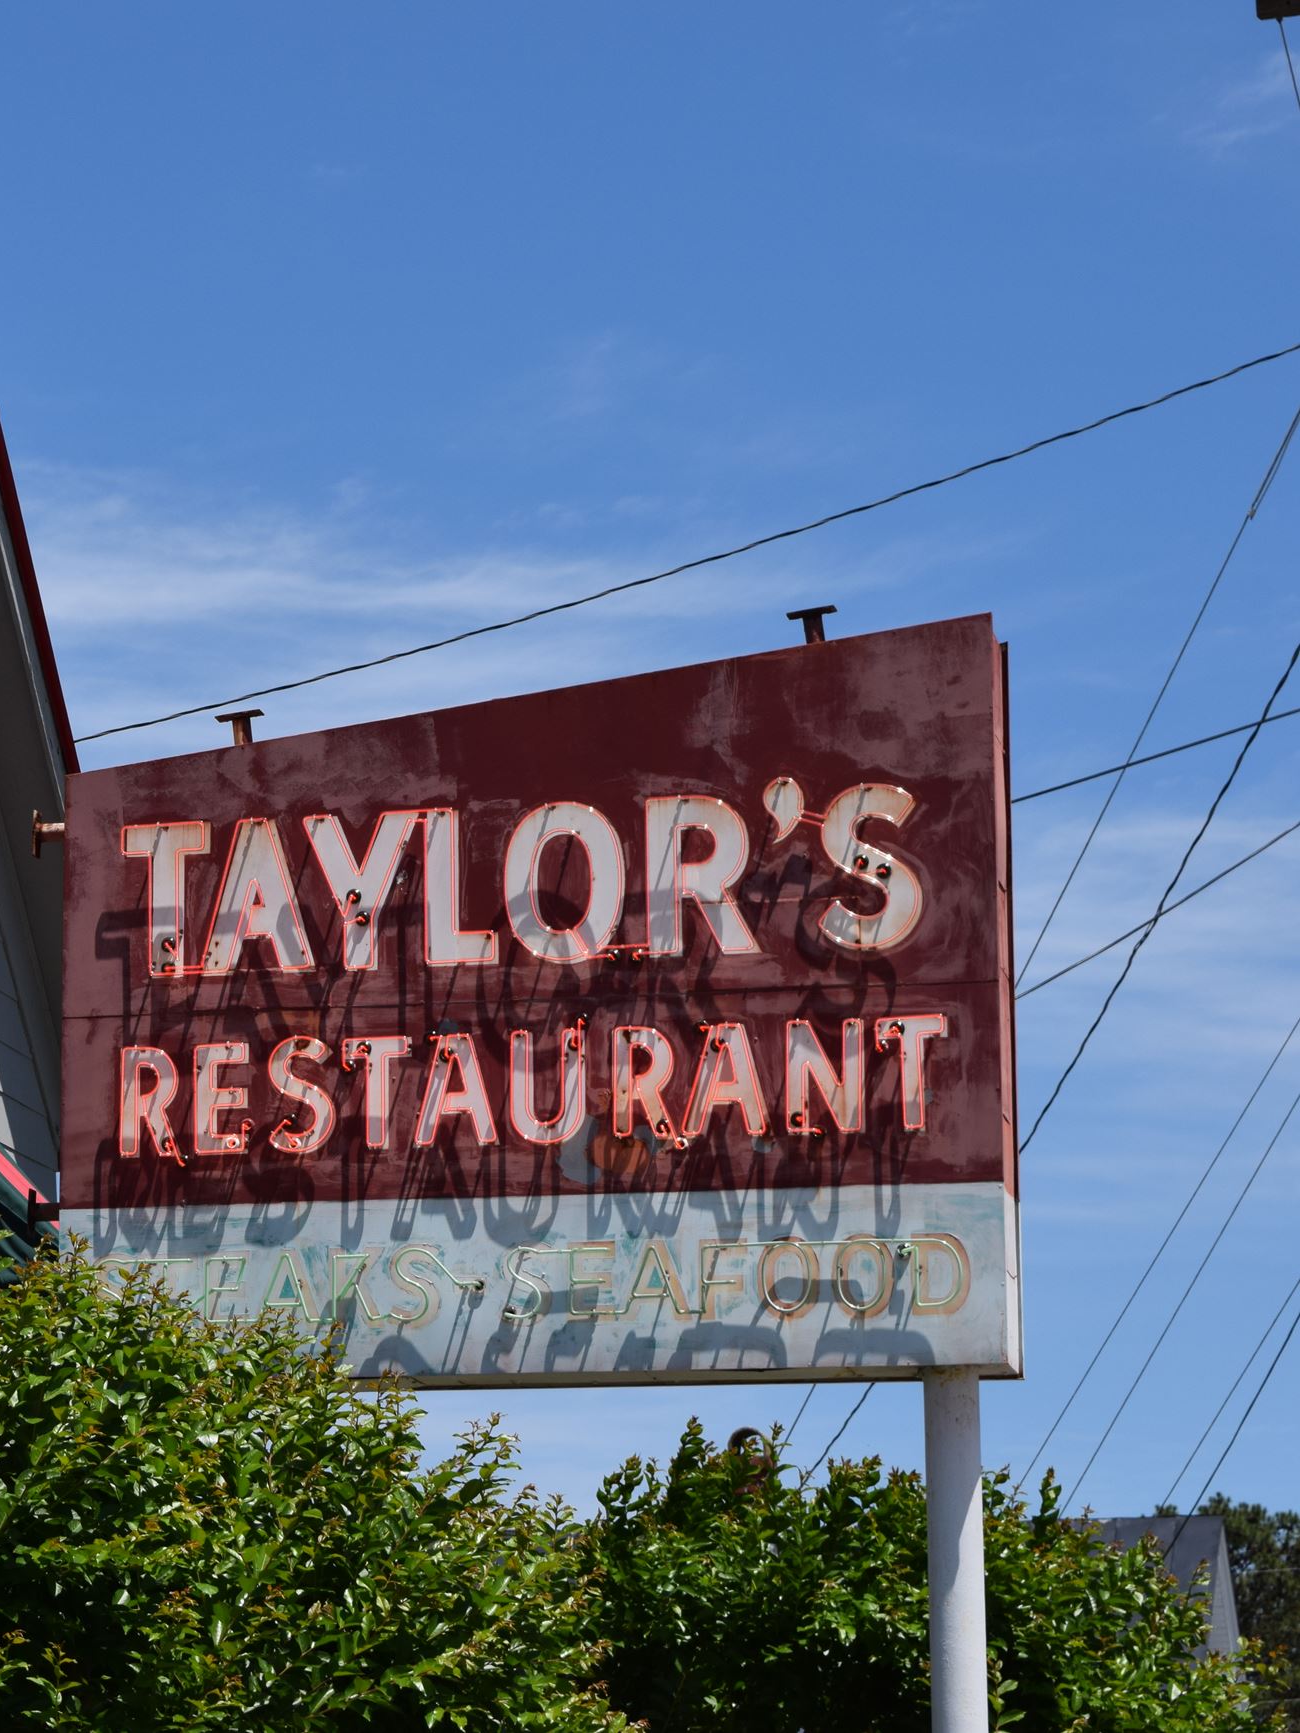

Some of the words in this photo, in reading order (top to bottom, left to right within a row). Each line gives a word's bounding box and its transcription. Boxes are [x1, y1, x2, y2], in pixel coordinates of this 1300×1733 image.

[120, 777, 922, 978] TAYLOR'S
[120, 1013, 948, 1163] RESTAURANT
[503, 1233, 971, 1325] SEAFOOD
